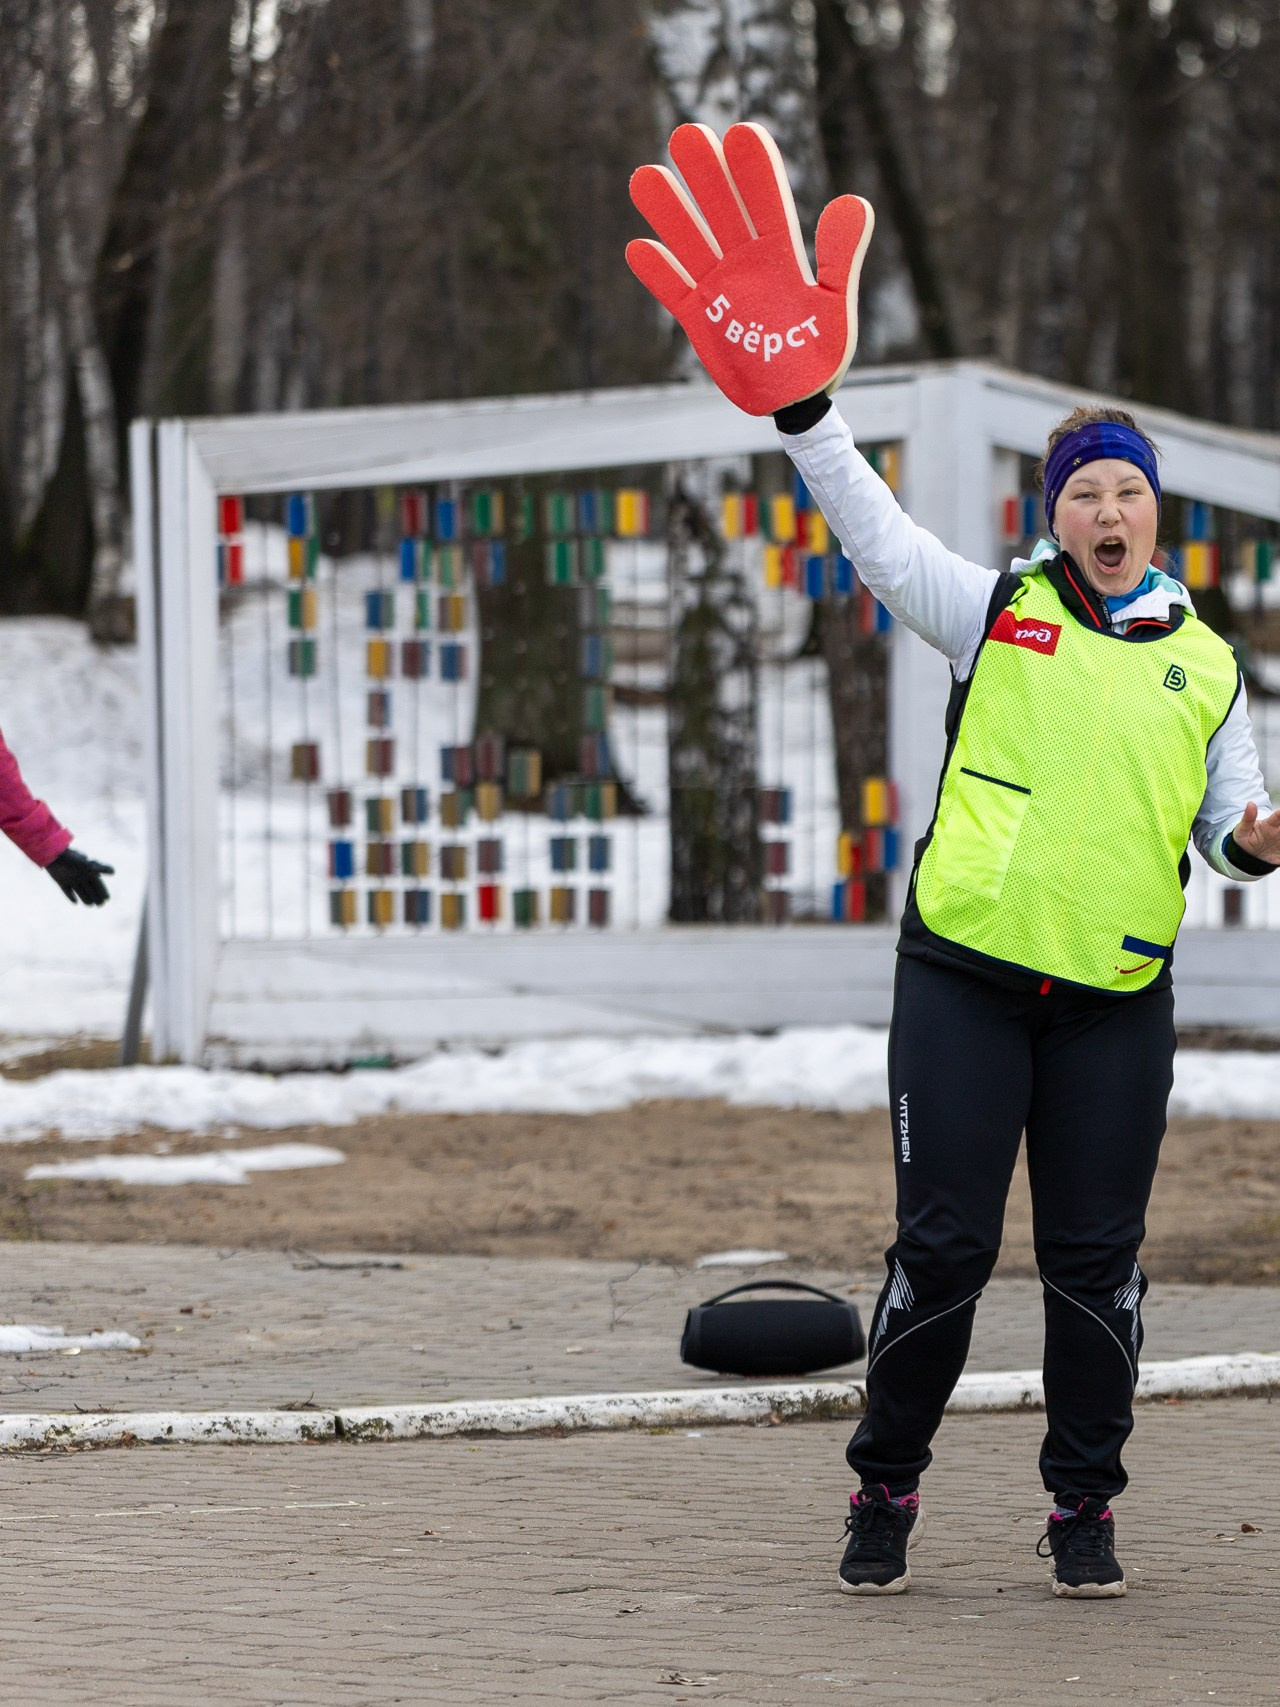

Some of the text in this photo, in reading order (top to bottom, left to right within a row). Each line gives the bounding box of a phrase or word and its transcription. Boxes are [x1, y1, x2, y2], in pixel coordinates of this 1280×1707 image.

[705, 294, 820, 361] 5 вёрст
[899, 1093, 911, 1163] VITZHEN
